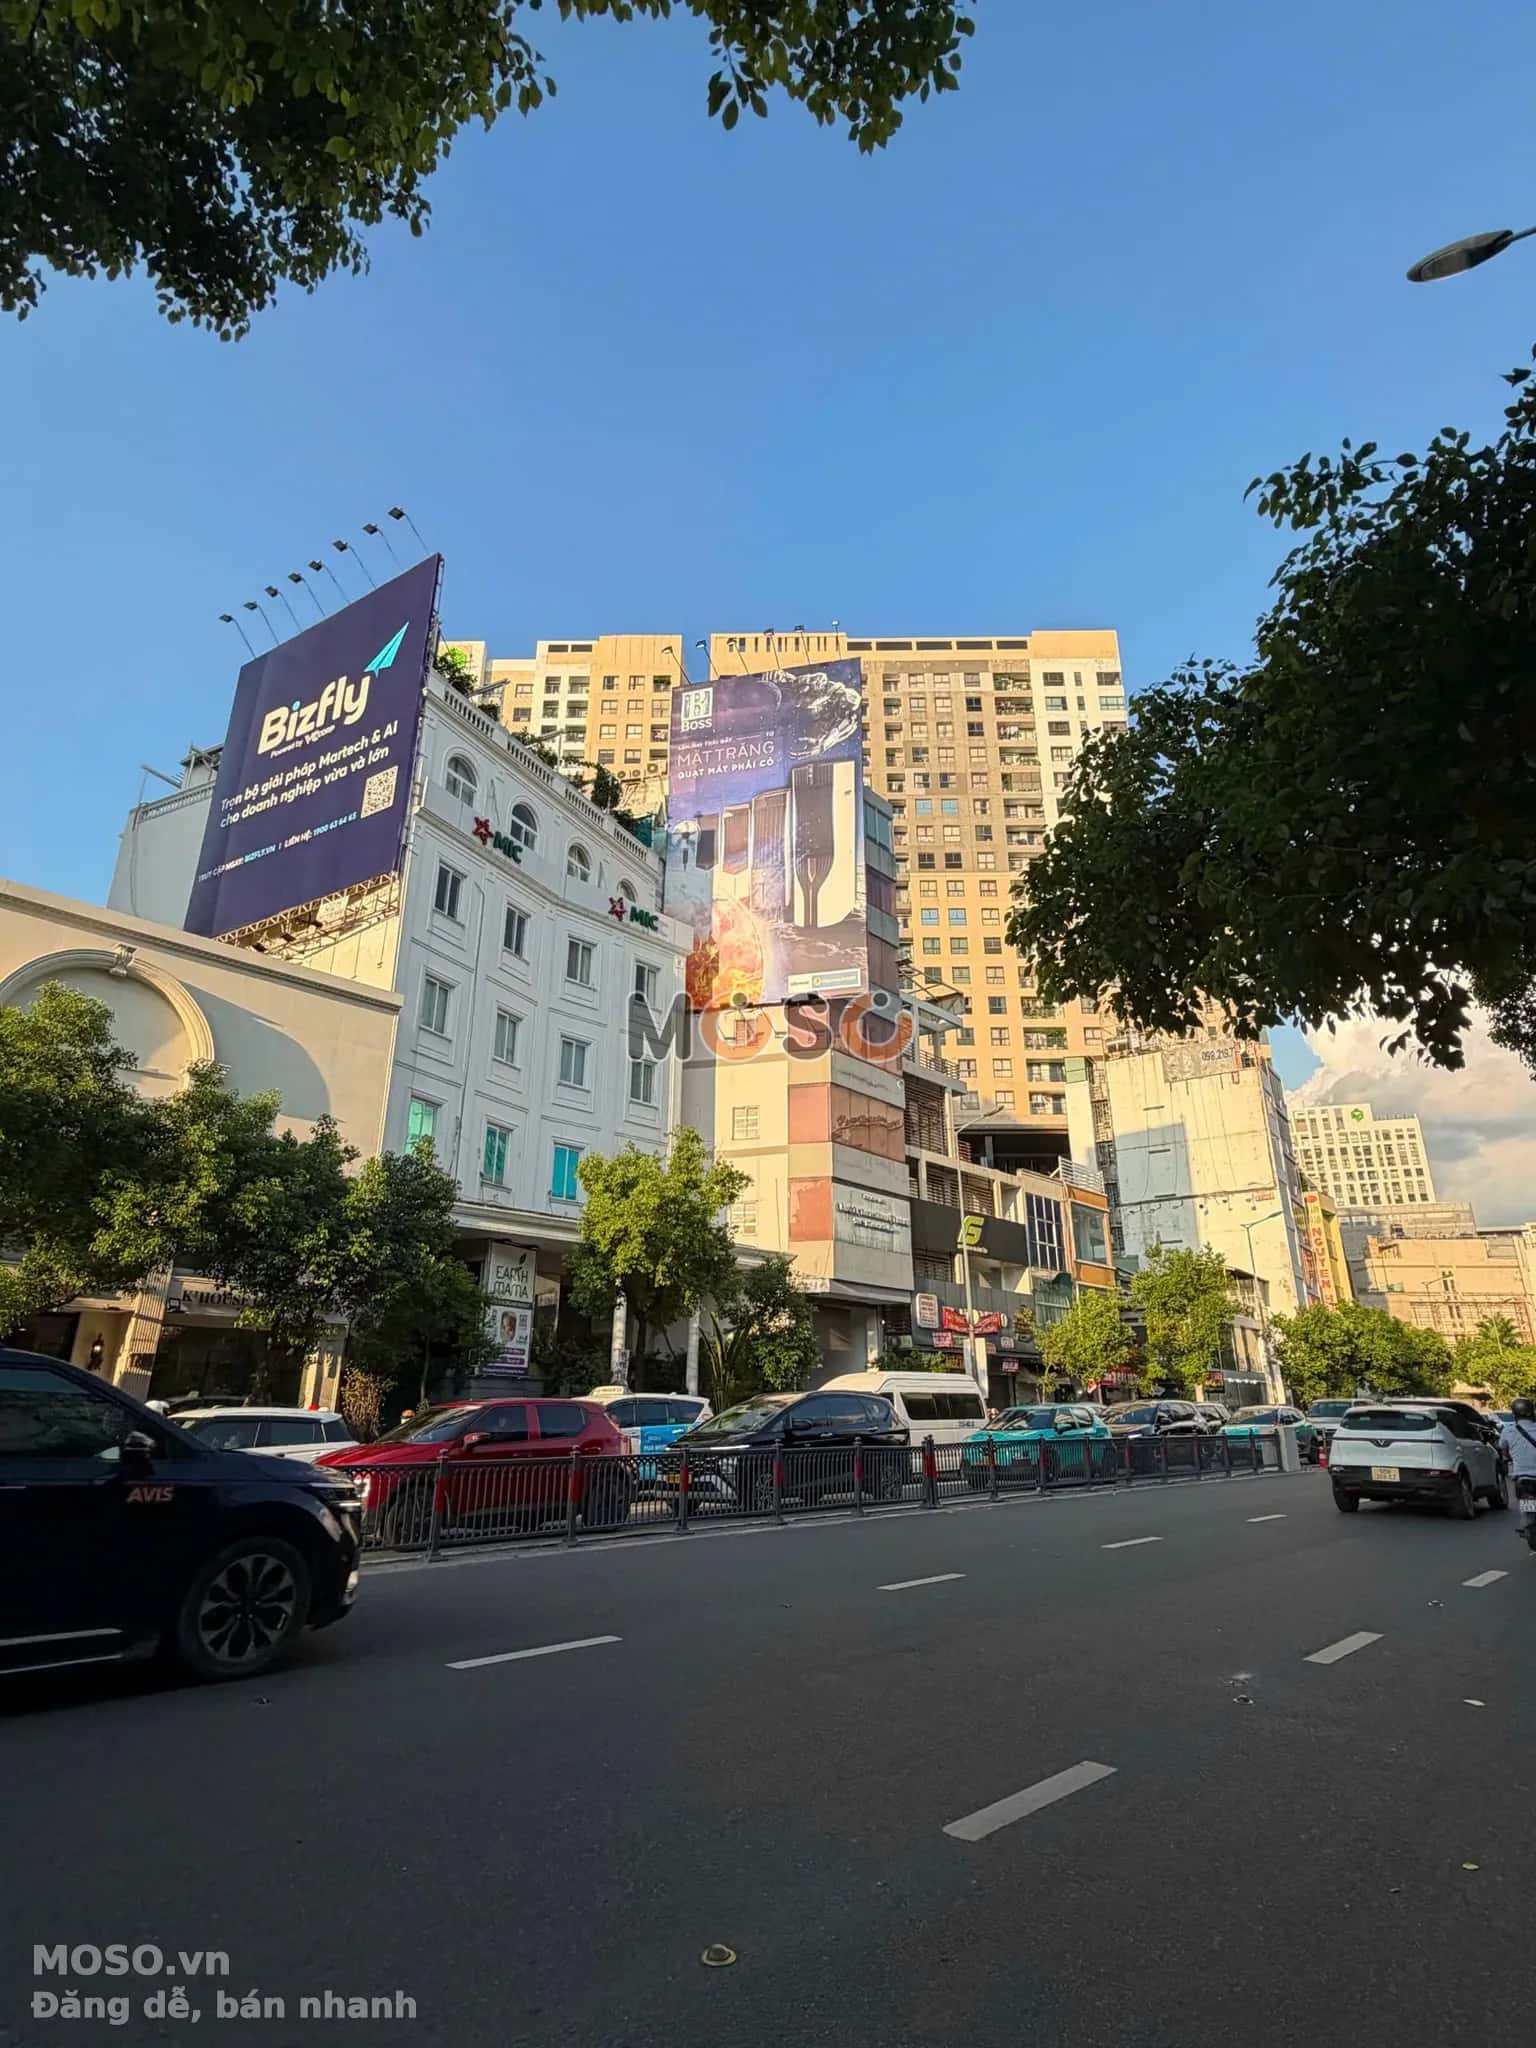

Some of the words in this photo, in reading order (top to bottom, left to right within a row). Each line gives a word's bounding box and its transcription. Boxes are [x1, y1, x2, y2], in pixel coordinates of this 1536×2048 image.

[258, 676, 371, 755] Bizfly
[681, 718, 713, 733] BOSS
[221, 794, 243, 812] Trọn
[244, 784, 259, 801] bộ
[261, 771, 283, 796] giải
[284, 760, 317, 785] pháp
[319, 735, 369, 769] Martech
[371, 728, 381, 743] &
[383, 720, 399, 739] AI
[219, 811, 240, 829] cho
[241, 793, 278, 819] doanh
[280, 777, 321, 804] nghiệp
[324, 766, 348, 785] vừa
[350, 755, 366, 772] và
[367, 746, 389, 765] lớn
[492, 831, 523, 865] MIC
[629, 905, 659, 932] MIC
[494, 1281, 529, 1299] MAMA
[126, 1487, 175, 1504] AVIS
